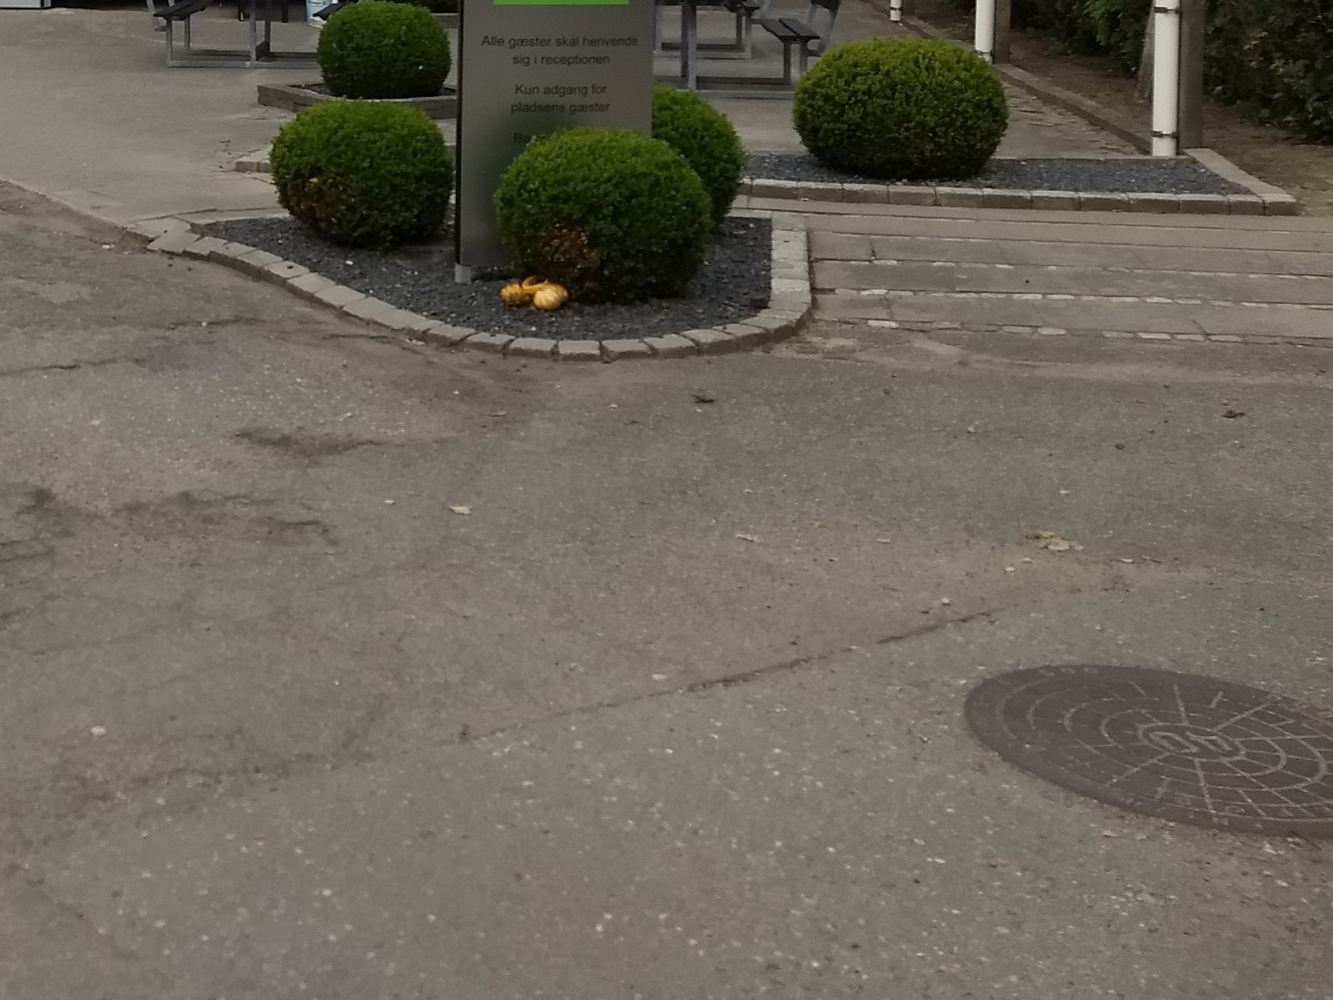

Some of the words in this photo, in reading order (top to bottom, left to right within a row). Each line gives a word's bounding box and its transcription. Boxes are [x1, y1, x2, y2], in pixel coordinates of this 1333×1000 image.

[481, 35, 504, 47] Alle
[508, 36, 551, 49] gæster
[555, 35, 579, 47] skal
[582, 35, 639, 47] henvende
[512, 54, 530, 67] sig
[540, 54, 610, 67] receptionen
[515, 84, 540, 96] Kun
[543, 84, 588, 98] adgang
[590, 83, 607, 96] for
[510, 101, 566, 115] pladsens
[569, 101, 610, 115] gæster
